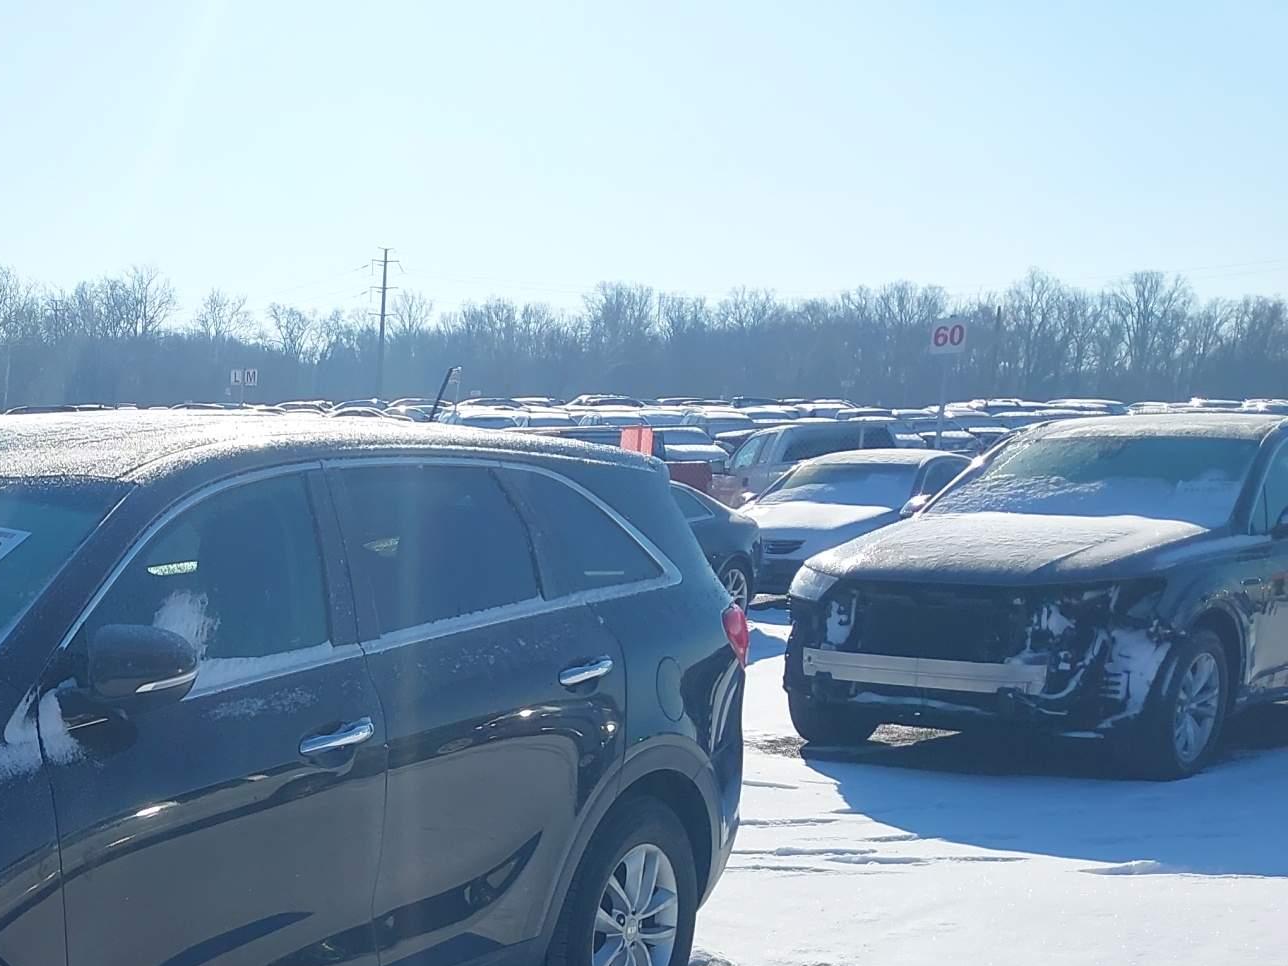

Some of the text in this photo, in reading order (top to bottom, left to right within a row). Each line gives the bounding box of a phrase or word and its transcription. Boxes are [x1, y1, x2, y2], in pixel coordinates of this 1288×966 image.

[934, 324, 964, 347] 60
[234, 370, 256, 383] L M
